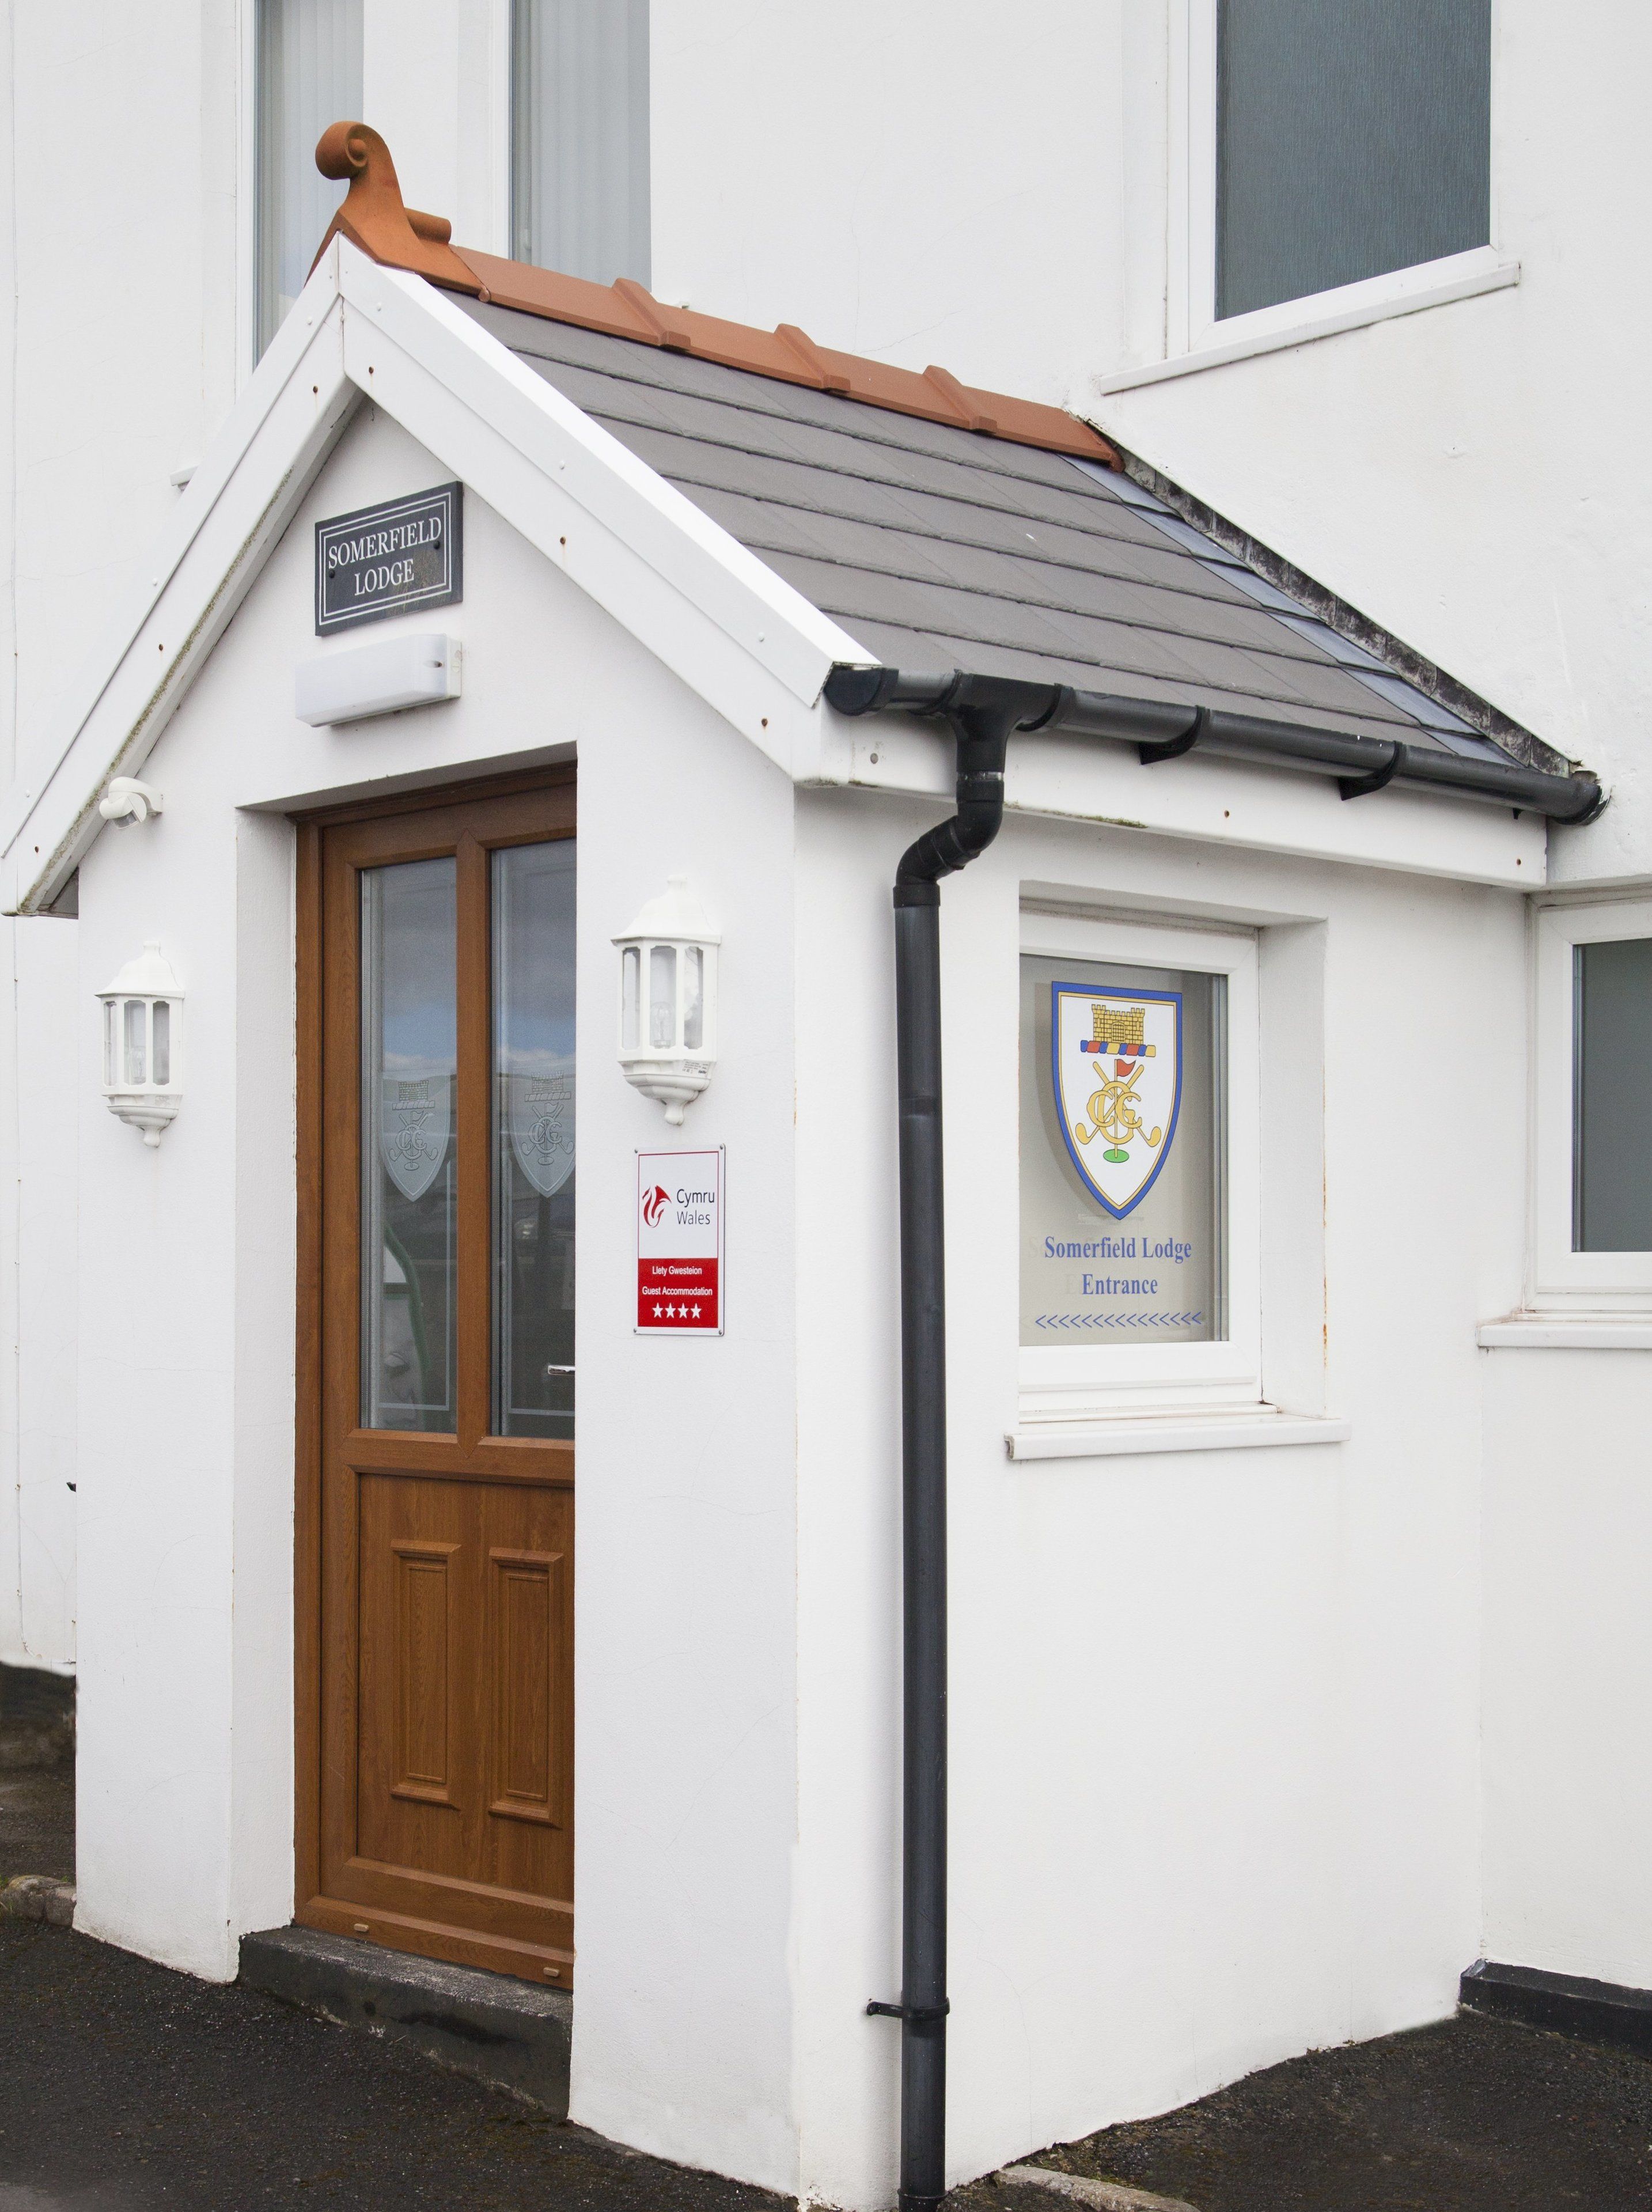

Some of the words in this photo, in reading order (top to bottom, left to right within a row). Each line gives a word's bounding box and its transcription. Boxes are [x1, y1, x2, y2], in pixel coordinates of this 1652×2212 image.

[328, 517, 442, 570] SOMERFIELD
[354, 558, 415, 596] LODGE
[676, 1188, 715, 1208] Cymru
[676, 1209, 711, 1225] Wales
[1044, 1236, 1136, 1259] Somerfield
[1142, 1237, 1192, 1264] Lodge
[652, 1266, 668, 1277] Llety
[668, 1266, 702, 1275] Gwesteion
[642, 1286, 661, 1296] Guest
[662, 1286, 713, 1296] Accommodation
[1081, 1273, 1158, 1295] Entrance
